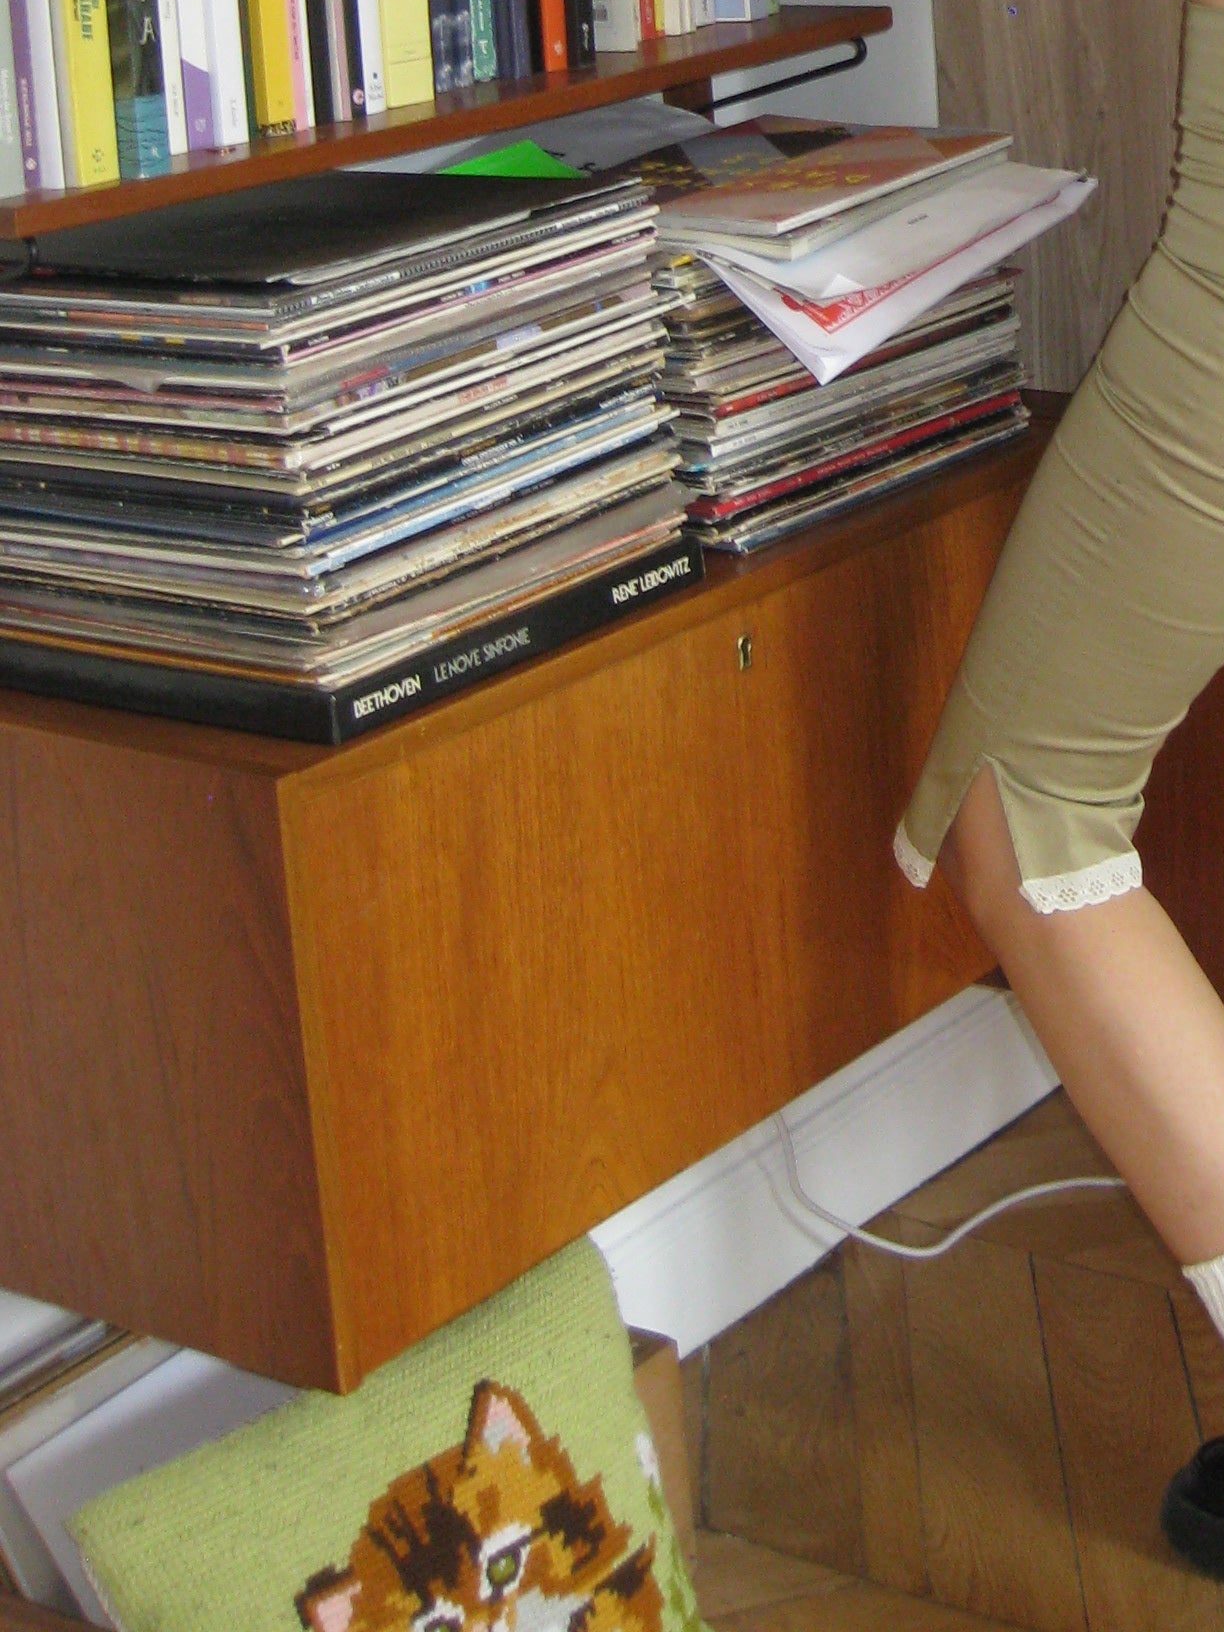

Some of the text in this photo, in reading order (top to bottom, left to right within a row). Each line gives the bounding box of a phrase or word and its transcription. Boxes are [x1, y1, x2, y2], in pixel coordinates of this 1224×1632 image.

[353, 674, 422, 720] BEETHOVEN
[434, 660, 448, 683] LE
[447, 649, 482, 676] NOVE
[483, 627, 533, 661] SINFONIE
